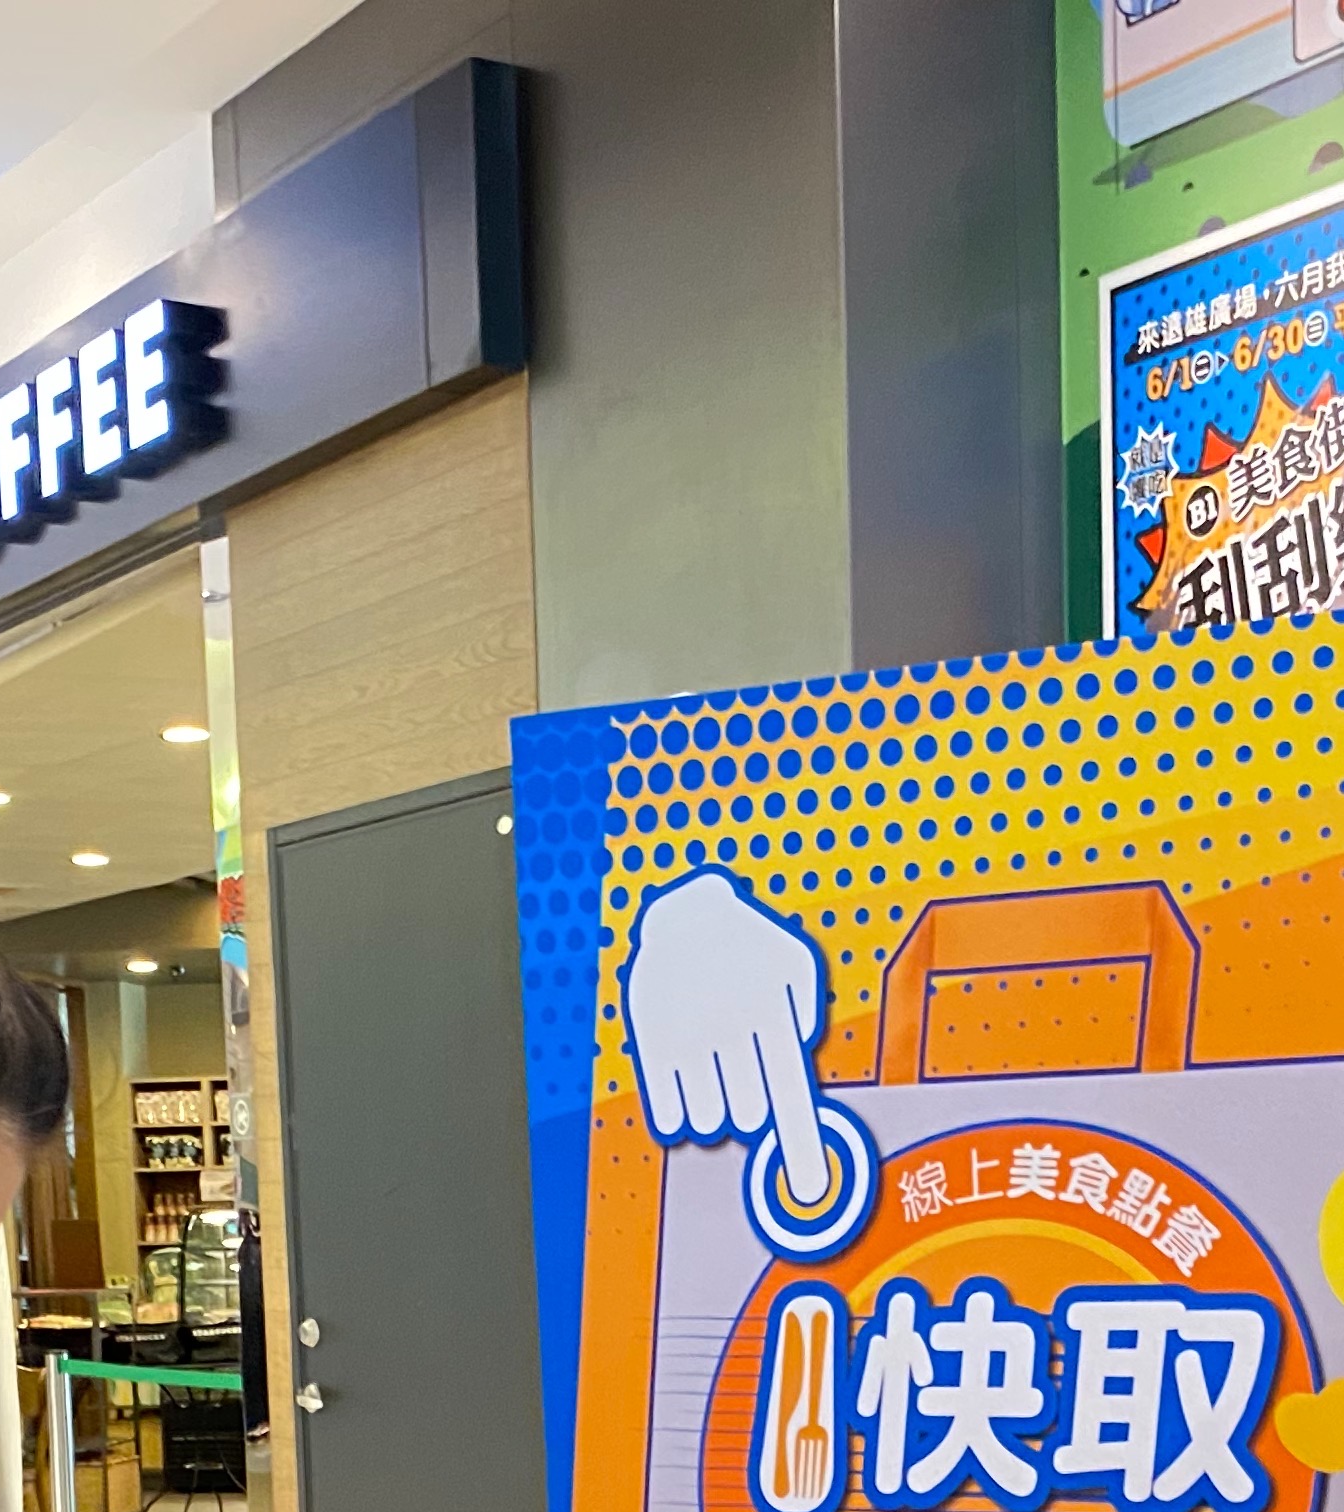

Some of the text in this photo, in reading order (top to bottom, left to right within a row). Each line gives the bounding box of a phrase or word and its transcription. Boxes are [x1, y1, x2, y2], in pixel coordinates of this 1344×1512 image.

[1188, 492, 1218, 530] B1
[898, 1143, 1222, 1278] 線上美食點餐
[858, 1292, 1265, 1502] 快取
